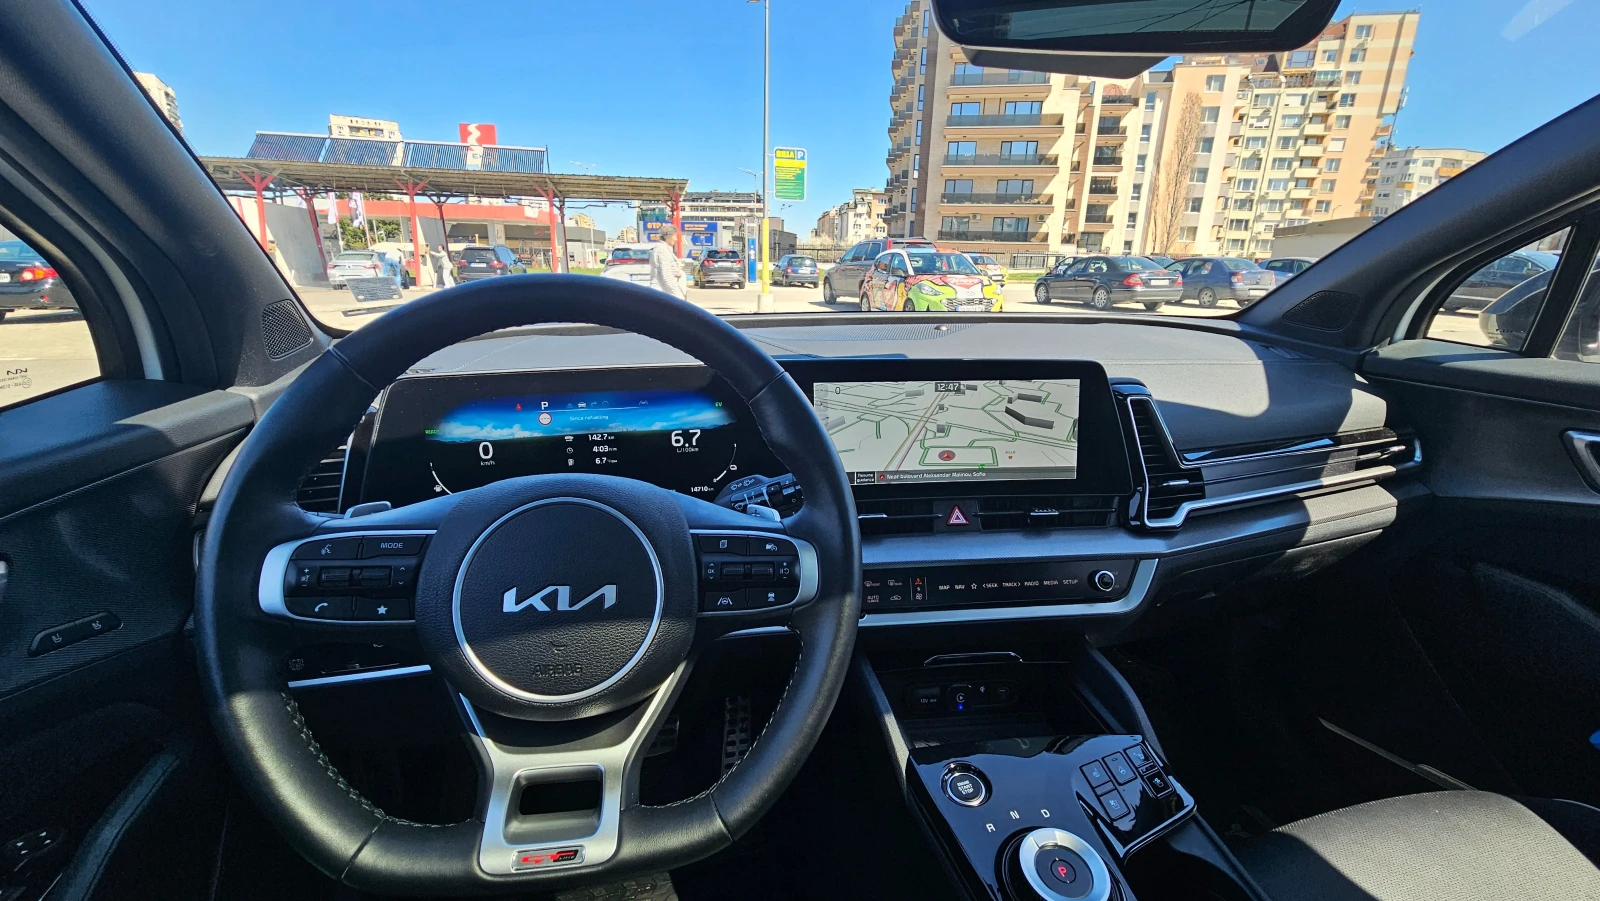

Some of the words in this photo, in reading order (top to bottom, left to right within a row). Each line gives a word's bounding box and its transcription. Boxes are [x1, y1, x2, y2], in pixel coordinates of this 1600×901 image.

[937, 383, 959, 391] 12:47
[541, 401, 549, 410] P
[671, 429, 701, 447] 6.7
[478, 441, 493, 459] 0
[595, 457, 607, 465] 6.7
[503, 584, 617, 613] KIA
[1010, 810, 1020, 820] N
[1040, 809, 1050, 818] D
[986, 824, 996, 832] R
[1058, 867, 1067, 877] P
